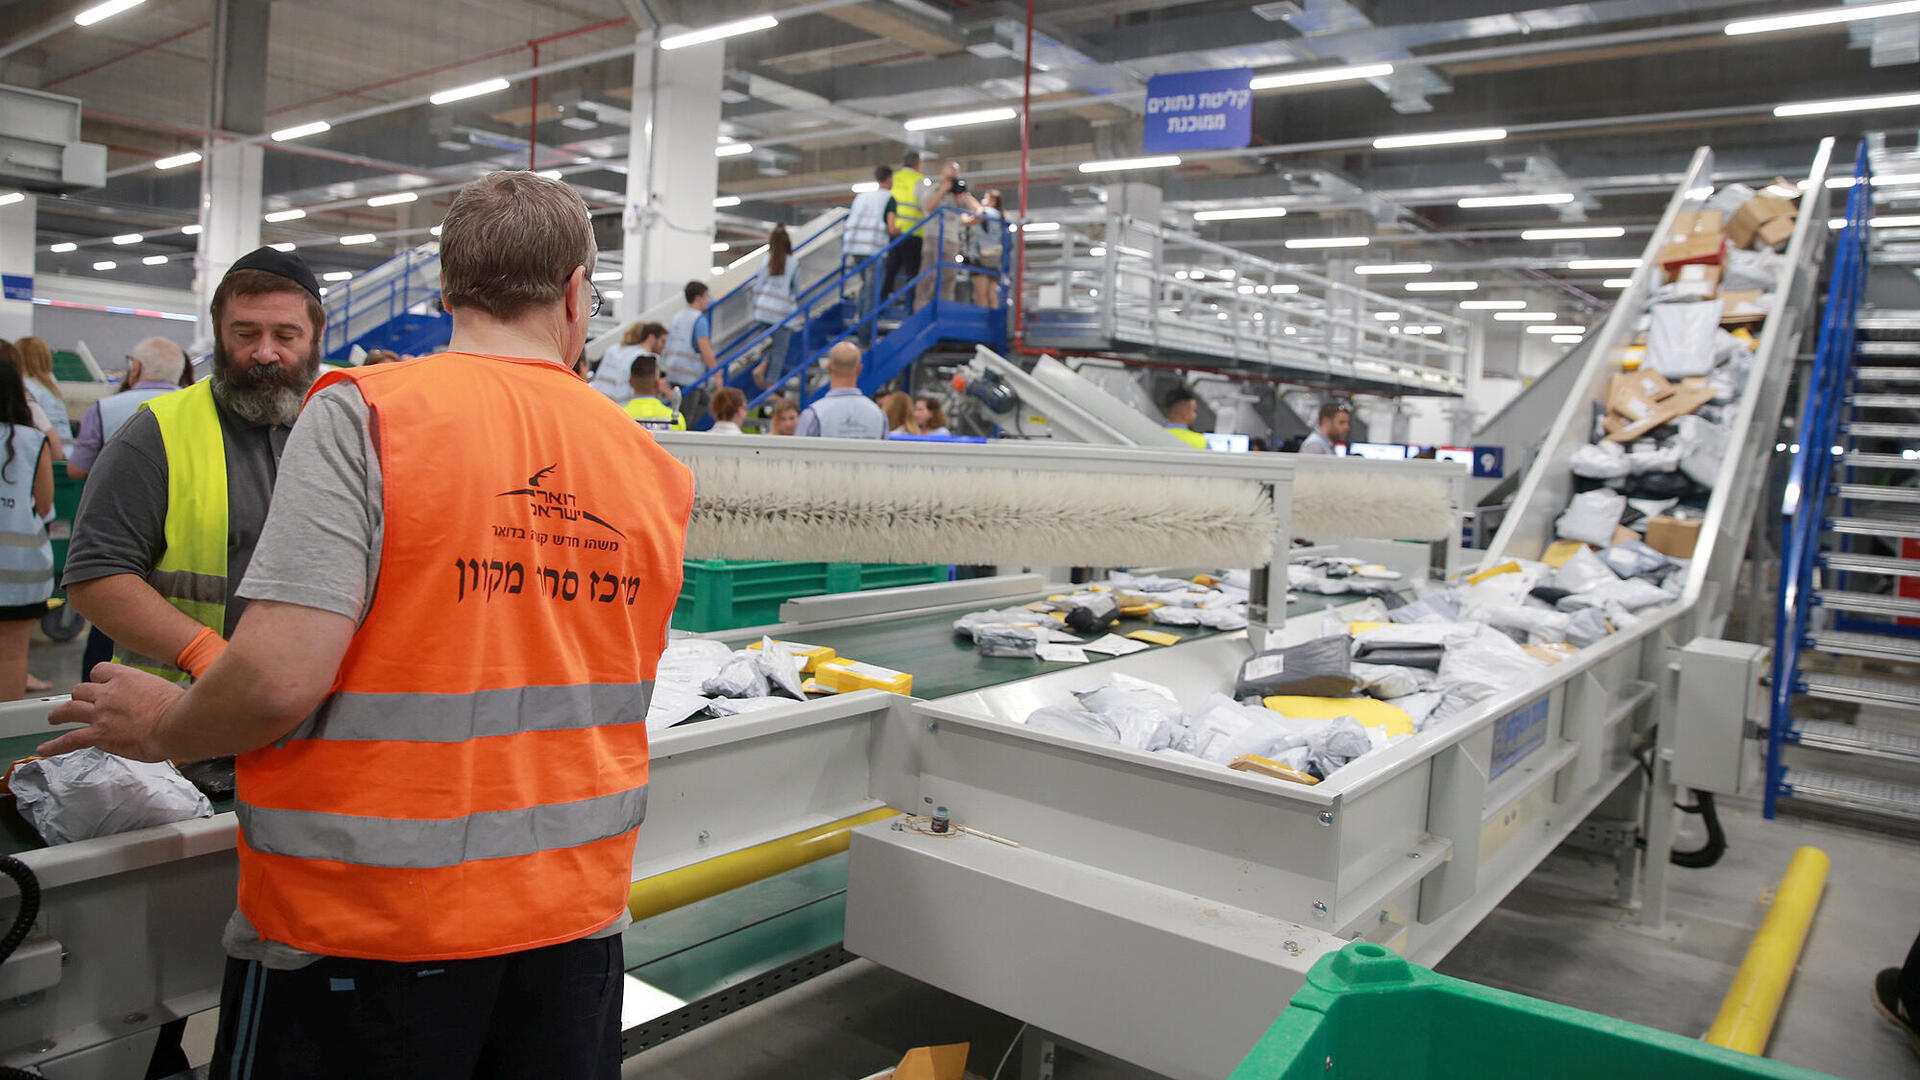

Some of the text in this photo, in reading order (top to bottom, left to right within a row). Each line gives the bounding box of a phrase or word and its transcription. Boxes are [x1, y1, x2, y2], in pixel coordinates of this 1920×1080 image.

[1147, 88, 1252, 114] קליטת נתונים
[1167, 113, 1226, 133] ממוכנת
[536, 490, 577, 508] דואר
[492, 525, 526, 539] בדואר
[553, 534, 580, 548] חדש
[584, 538, 619, 552] משהו
[455, 557, 524, 604] מקוון
